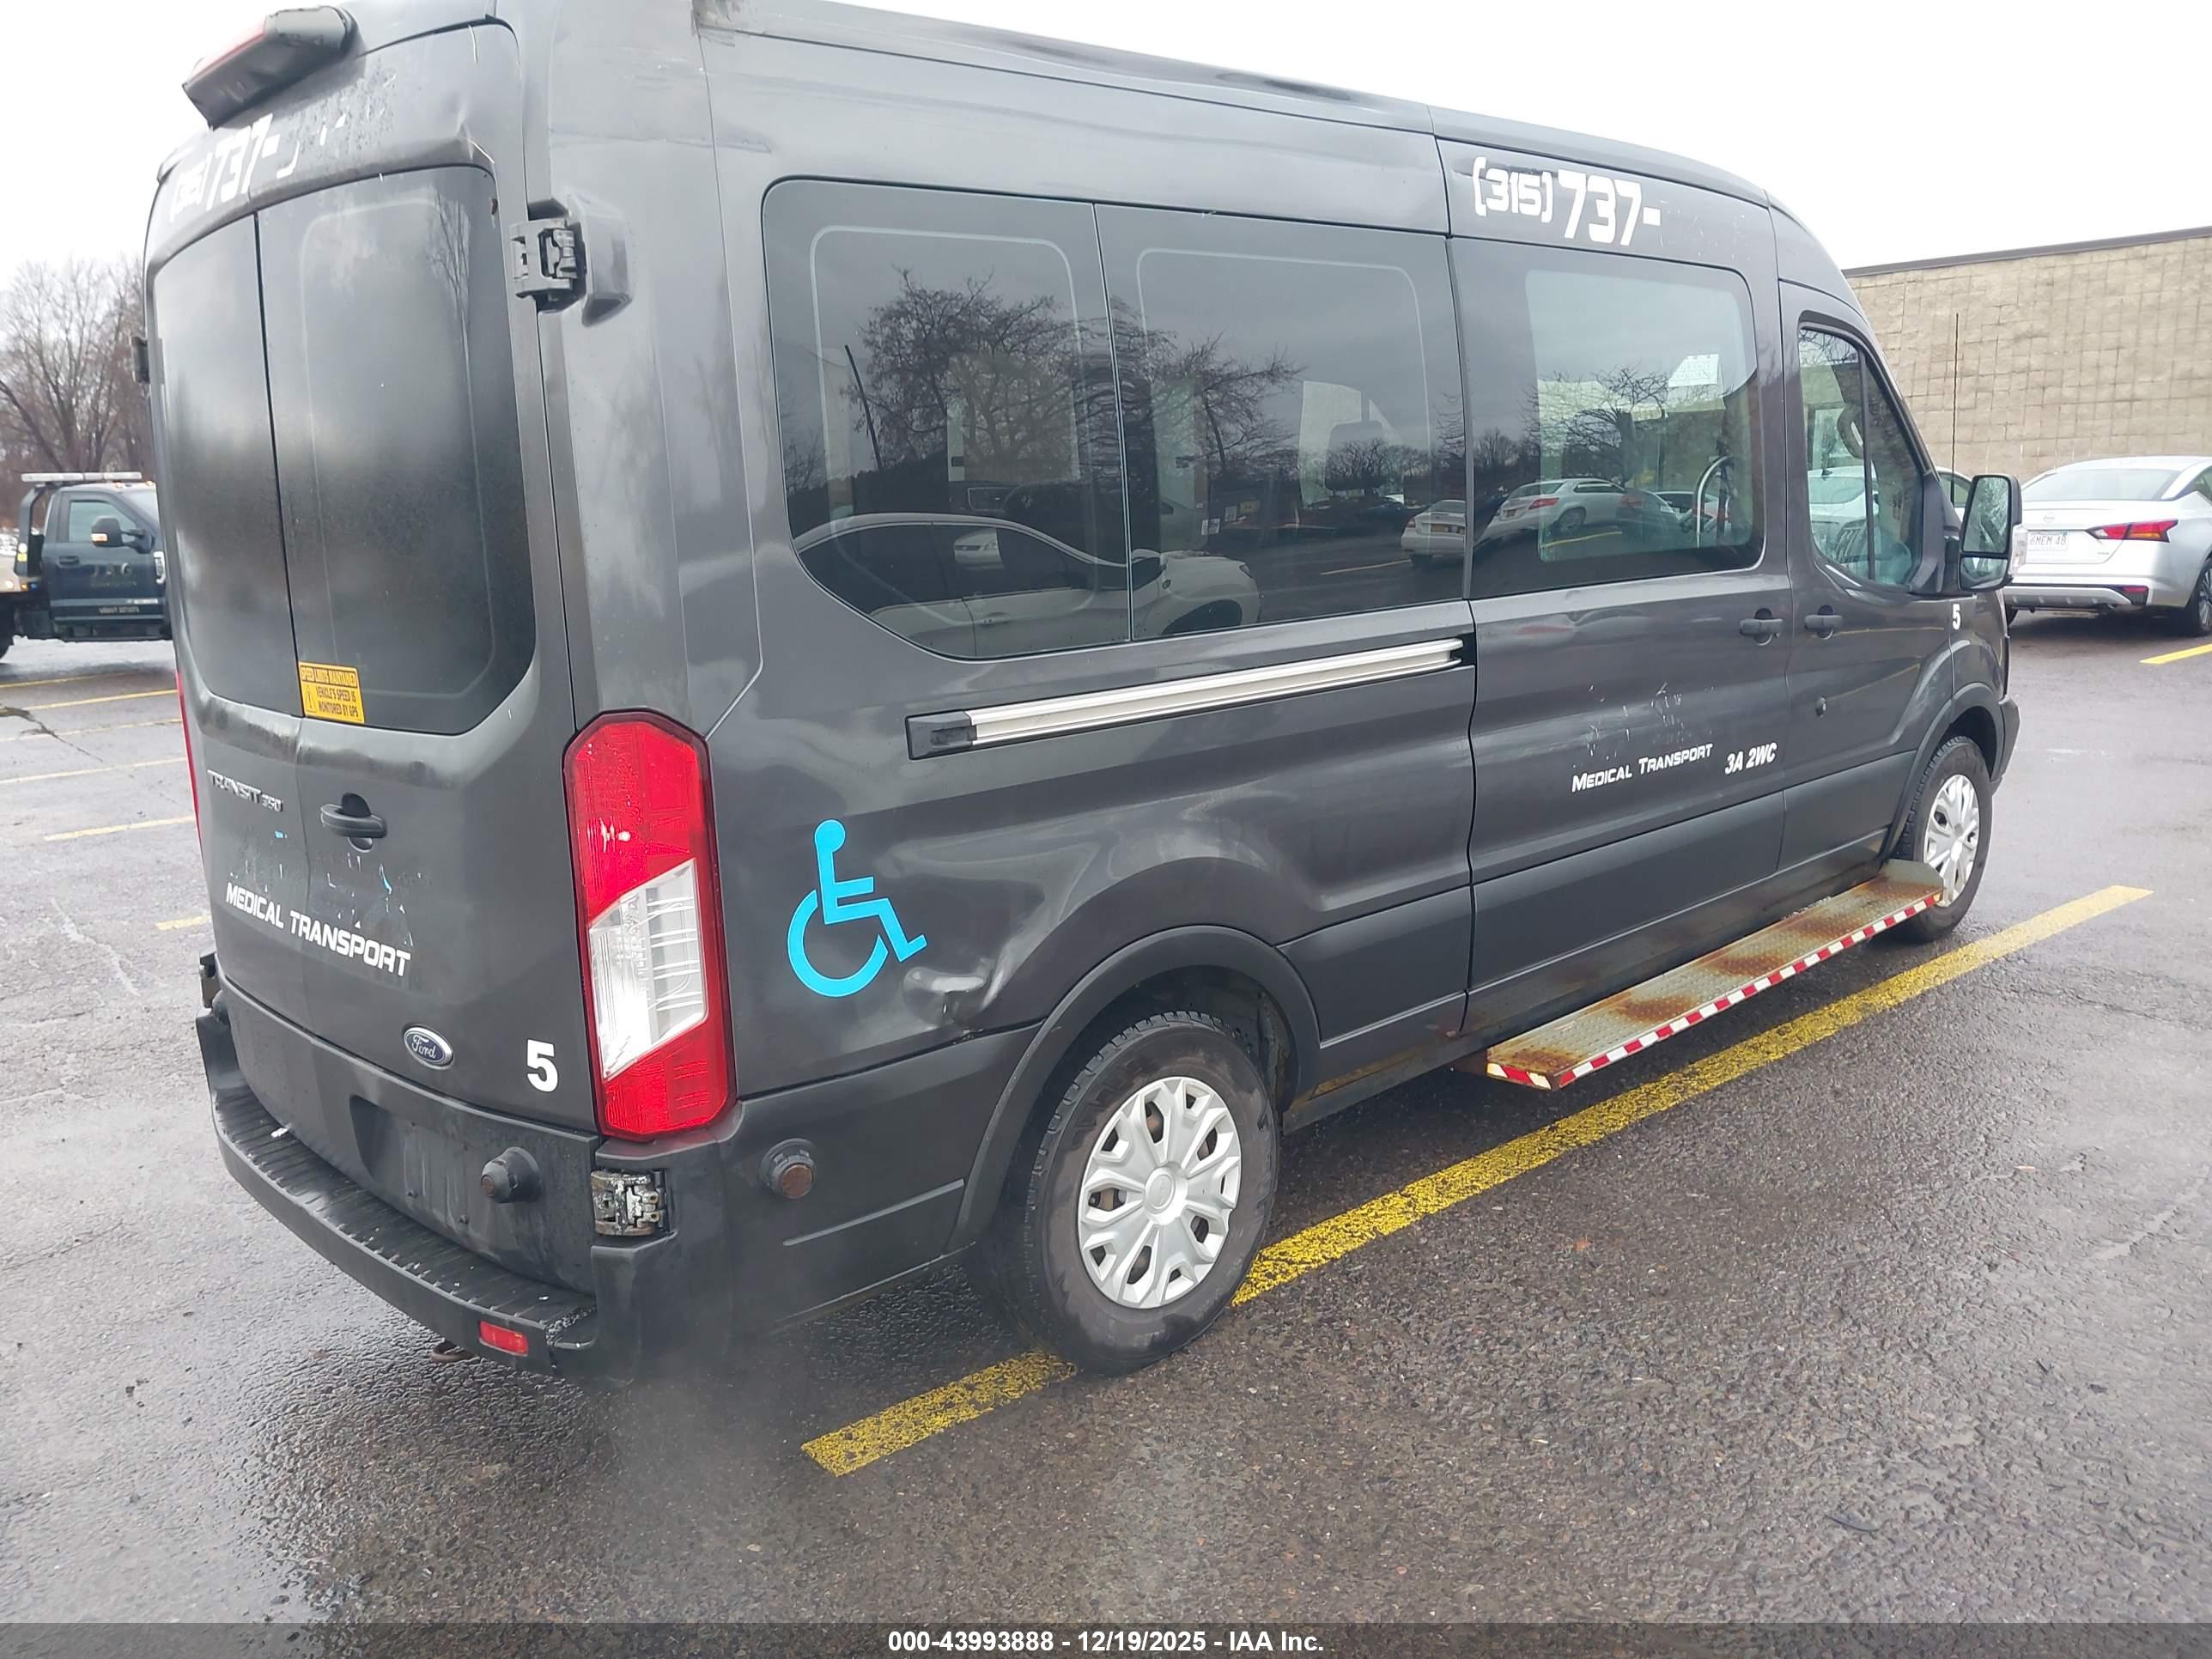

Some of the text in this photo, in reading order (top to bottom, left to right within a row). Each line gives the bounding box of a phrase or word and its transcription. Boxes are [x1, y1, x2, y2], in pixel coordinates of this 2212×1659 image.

[1952, 604, 1961, 630] 5
[337, 689, 350, 702] SPEED
[1571, 743, 1778, 793] MEDICAL TRANSPORT 3A 2WC
[207, 769, 262, 804] TRANSIT
[226, 882, 411, 977] MEDICAL TRANSPORT
[411, 1033, 438, 1059] Ford
[526, 1039, 559, 1092] 5
